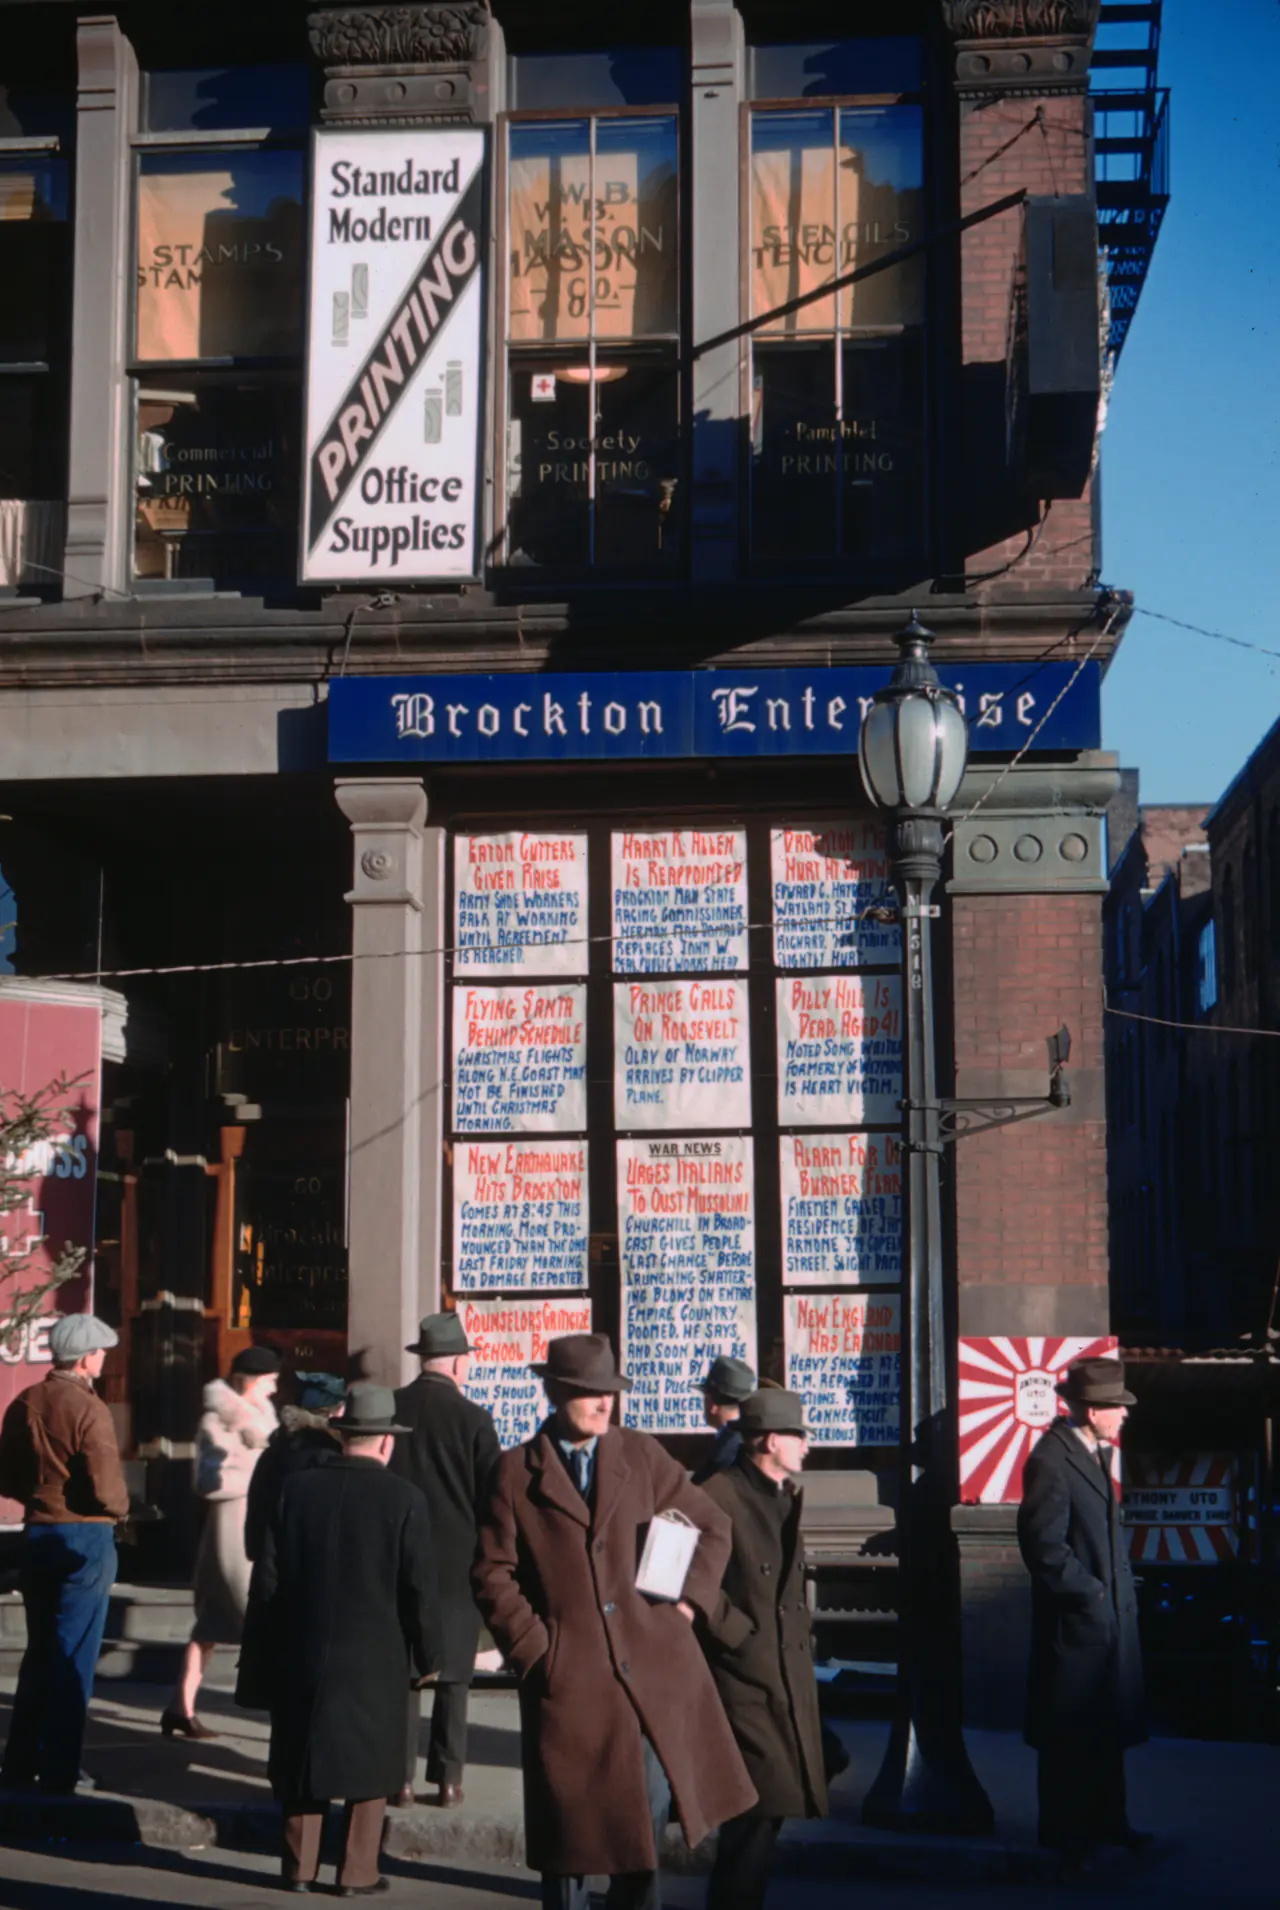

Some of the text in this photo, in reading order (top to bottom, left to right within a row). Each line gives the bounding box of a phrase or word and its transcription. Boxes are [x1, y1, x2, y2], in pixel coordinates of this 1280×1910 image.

[331, 157, 460, 198] Standard
[327, 206, 431, 245] Modern
[762, 221, 910, 247] STENCILS
[153, 241, 283, 266] STAMPS
[318, 219, 476, 503] PRINTING
[163, 439, 273, 462] Commercial
[539, 461, 649, 483] PRINTING
[782, 452, 893, 475] PRINTING
[165, 472, 272, 493] PRINTING
[361, 466, 463, 504] Office
[329, 514, 466, 568] Supplies
[390, 683, 1036, 738] Brockton Enterise
[520, 833, 575, 862] CUTTERS
[623, 831, 734, 859] HARRY ALLEN
[474, 862, 560, 890] GIVEN RAISE
[626, 861, 742, 887] IS REAPPOINTED
[786, 858, 820, 881] HURT
[459, 891, 579, 909] ARMY WORKERS
[615, 886, 735, 906] BROCKTON MAN STATE
[775, 882, 816, 899] EDWARD
[459, 911, 578, 926] BALK AT WORKING
[615, 904, 743, 922] RACING COMMISSIONER
[459, 928, 568, 946] UNTIL AGREEMENT
[616, 941, 673, 955] REPLACES
[630, 983, 735, 1014] PRINCE CALLS
[792, 979, 889, 1010] BILLY HILL IS
[466, 990, 574, 1020] FLYING SANTA
[468, 1020, 582, 1046] BEHIND SCHEDULE
[634, 1014, 738, 1042] ON ROOSEVELT
[841, 1010, 898, 1037] AGED 41
[228, 1027, 349, 1050] ENTERPR
[458, 1047, 573, 1066] CHRISTMAS FLIGHTS
[665, 1043, 737, 1063] OF NORWAY
[786, 1039, 854, 1058] NOTED SONG
[458, 1066, 585, 1082] ALONG COAST MAY
[626, 1067, 743, 1084] ARRIVES BY CLIPPER
[786, 1059, 858, 1076] FORMERLY OF
[458, 1084, 564, 1099] NOT BE FINISHED
[786, 1079, 841, 1096] IS HEART
[457, 1100, 557, 1114] UNTIL CHRISTMAS
[648, 1142, 721, 1154] WAR NEWS
[794, 1138, 841, 1167] ALARM
[849, 1136, 878, 1167] FOR
[468, 1144, 584, 1175] NEW EARTHQUAKE
[627, 1158, 743, 1184] URGES ITALIANS
[475, 1174, 581, 1202] HITS BROCKTON
[800, 1170, 860, 1196] BURNER
[627, 1186, 748, 1213] TO OUST MUSSOLINI
[788, 1197, 838, 1216] FIREMEN
[461, 1201, 581, 1220] COMES AT 8:45 THIS
[519, 1221, 548, 1236] MORE
[626, 1215, 709, 1232] CHURCHILL IN
[788, 1217, 854, 1235] RESIDENCE
[461, 1238, 566, 1254] NOUNCED THAN THE
[626, 1234, 741, 1251] CAST GIVES PEOPLE
[459, 1256, 528, 1271] LAST FRIDAY
[718, 1250, 752, 1266] BEFORE
[834, 1254, 871, 1271] SLIGHT
[461, 1272, 525, 1288] NO DAMAGE
[627, 1271, 696, 1286] LAUNCHING
[628, 1288, 714, 1304] ING BLOWS ON
[466, 1302, 590, 1333] COUNSELORS CRITICIZE
[681, 1304, 736, 1321] COUNTRY
[798, 1296, 893, 1329] NEW ENGLAND
[683, 1324, 699, 1338] HE
[474, 1336, 524, 1362] SCHOOL
[810, 1329, 838, 1353] HAS
[628, 1343, 746, 1359] AND SOON WILL BE
[627, 1361, 682, 1377] OVERRUN
[689, 1360, 702, 1376] BY
[790, 1354, 892, 1371] HEAVY SHOCKS AT
[501, 1366, 527, 1380] MORE
[820, 1373, 890, 1388] REPORTED IN
[494, 1385, 537, 1399] SHOULD
[502, 1402, 538, 1416] GIVEN
[628, 1398, 659, 1412] IN NO
[624, 1414, 686, 1428] AS HE HINTS
[808, 1407, 887, 1423] CONNECTICUT
[512, 1419, 530, 1432] FOR
